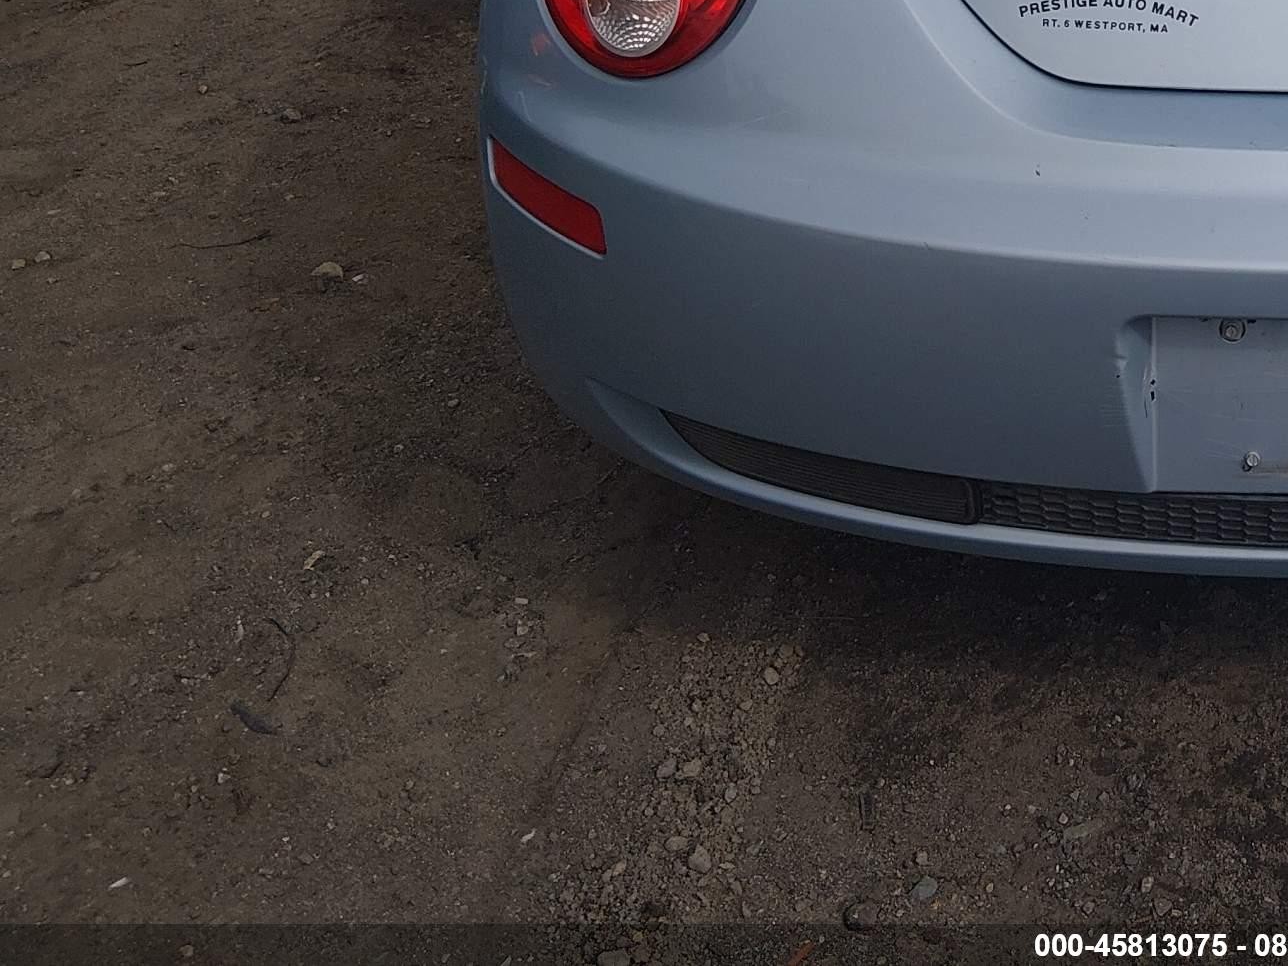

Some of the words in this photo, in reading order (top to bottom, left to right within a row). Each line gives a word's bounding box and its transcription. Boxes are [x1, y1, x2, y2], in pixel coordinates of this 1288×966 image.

[1151, 1, 1199, 27] MART
[1042, 18, 1060, 28] RT.
[1063, 19, 1070, 28] 6
[1074, 20, 1146, 33] WESTPORT,
[1149, 23, 1168, 33] MA
